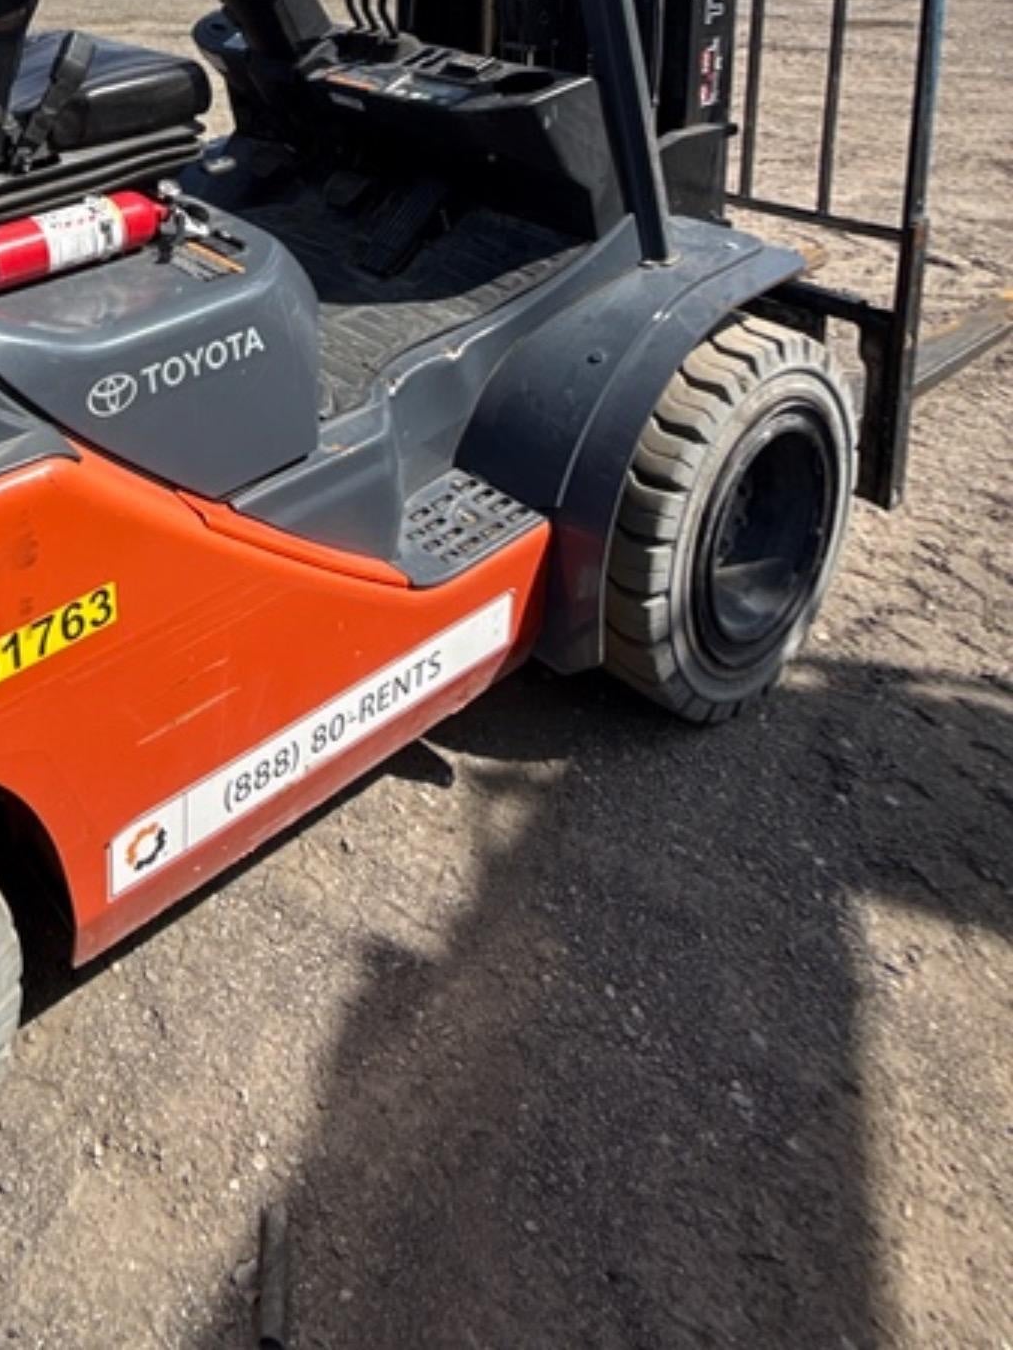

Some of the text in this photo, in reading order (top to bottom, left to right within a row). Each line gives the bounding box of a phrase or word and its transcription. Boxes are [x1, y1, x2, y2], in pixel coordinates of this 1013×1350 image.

[142, 327, 265, 394] TOYOTA
[223, 650, 444, 814] (888) 80-RENTS
